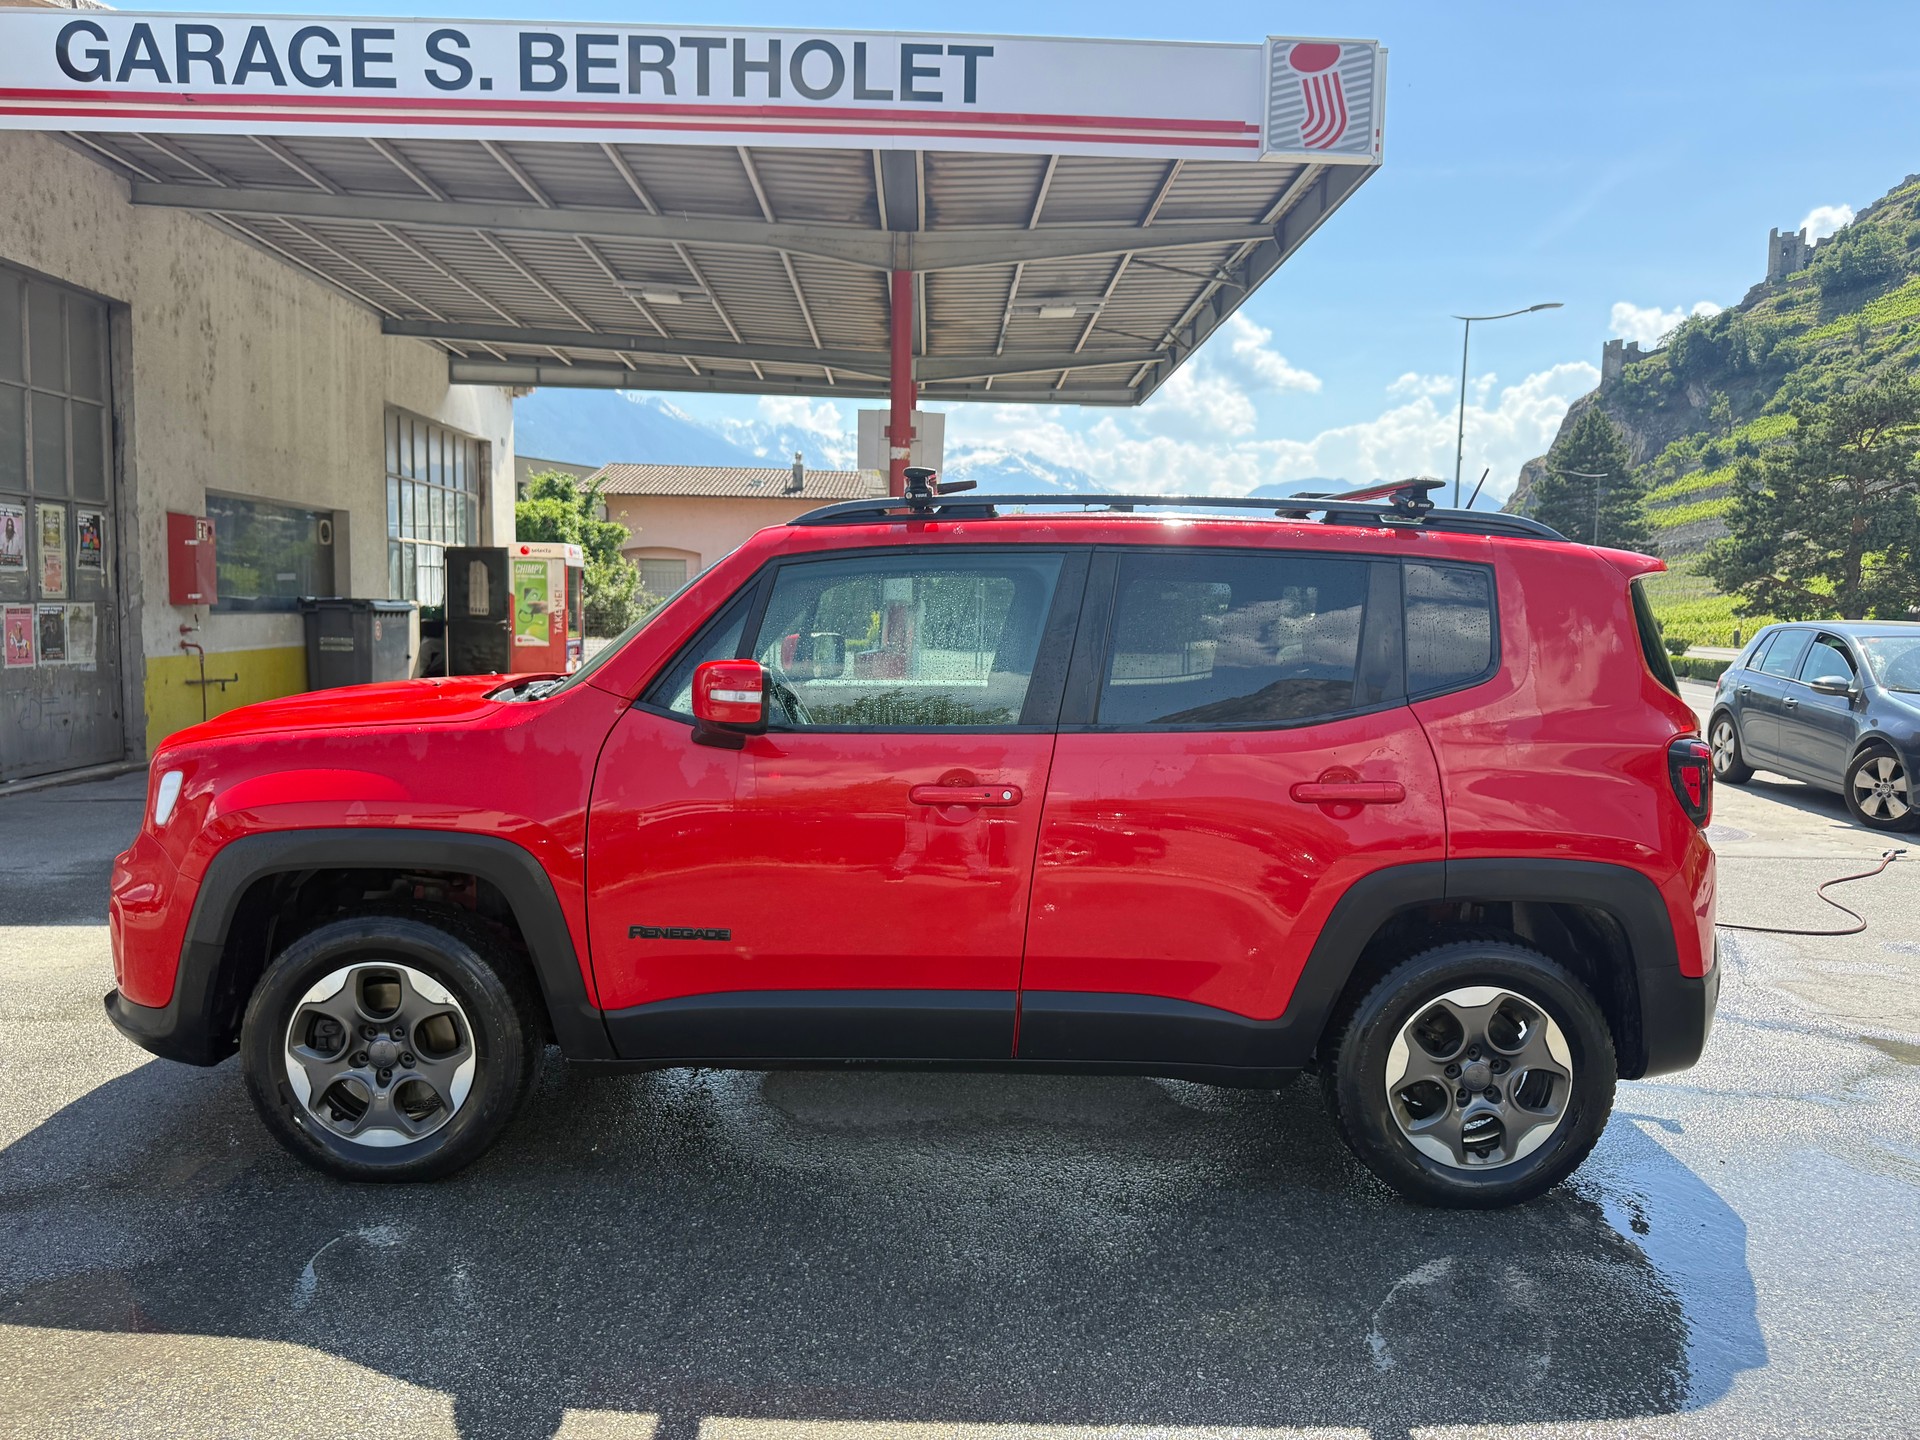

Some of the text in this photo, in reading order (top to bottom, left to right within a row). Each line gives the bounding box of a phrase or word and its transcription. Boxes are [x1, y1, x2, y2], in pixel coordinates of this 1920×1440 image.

[55, 19, 995, 104] GARAGE S. BERTHOLET
[515, 563, 544, 575] CHIMPY
[554, 589, 564, 635] TAKE ME!
[628, 925, 731, 942] RENEGADE
